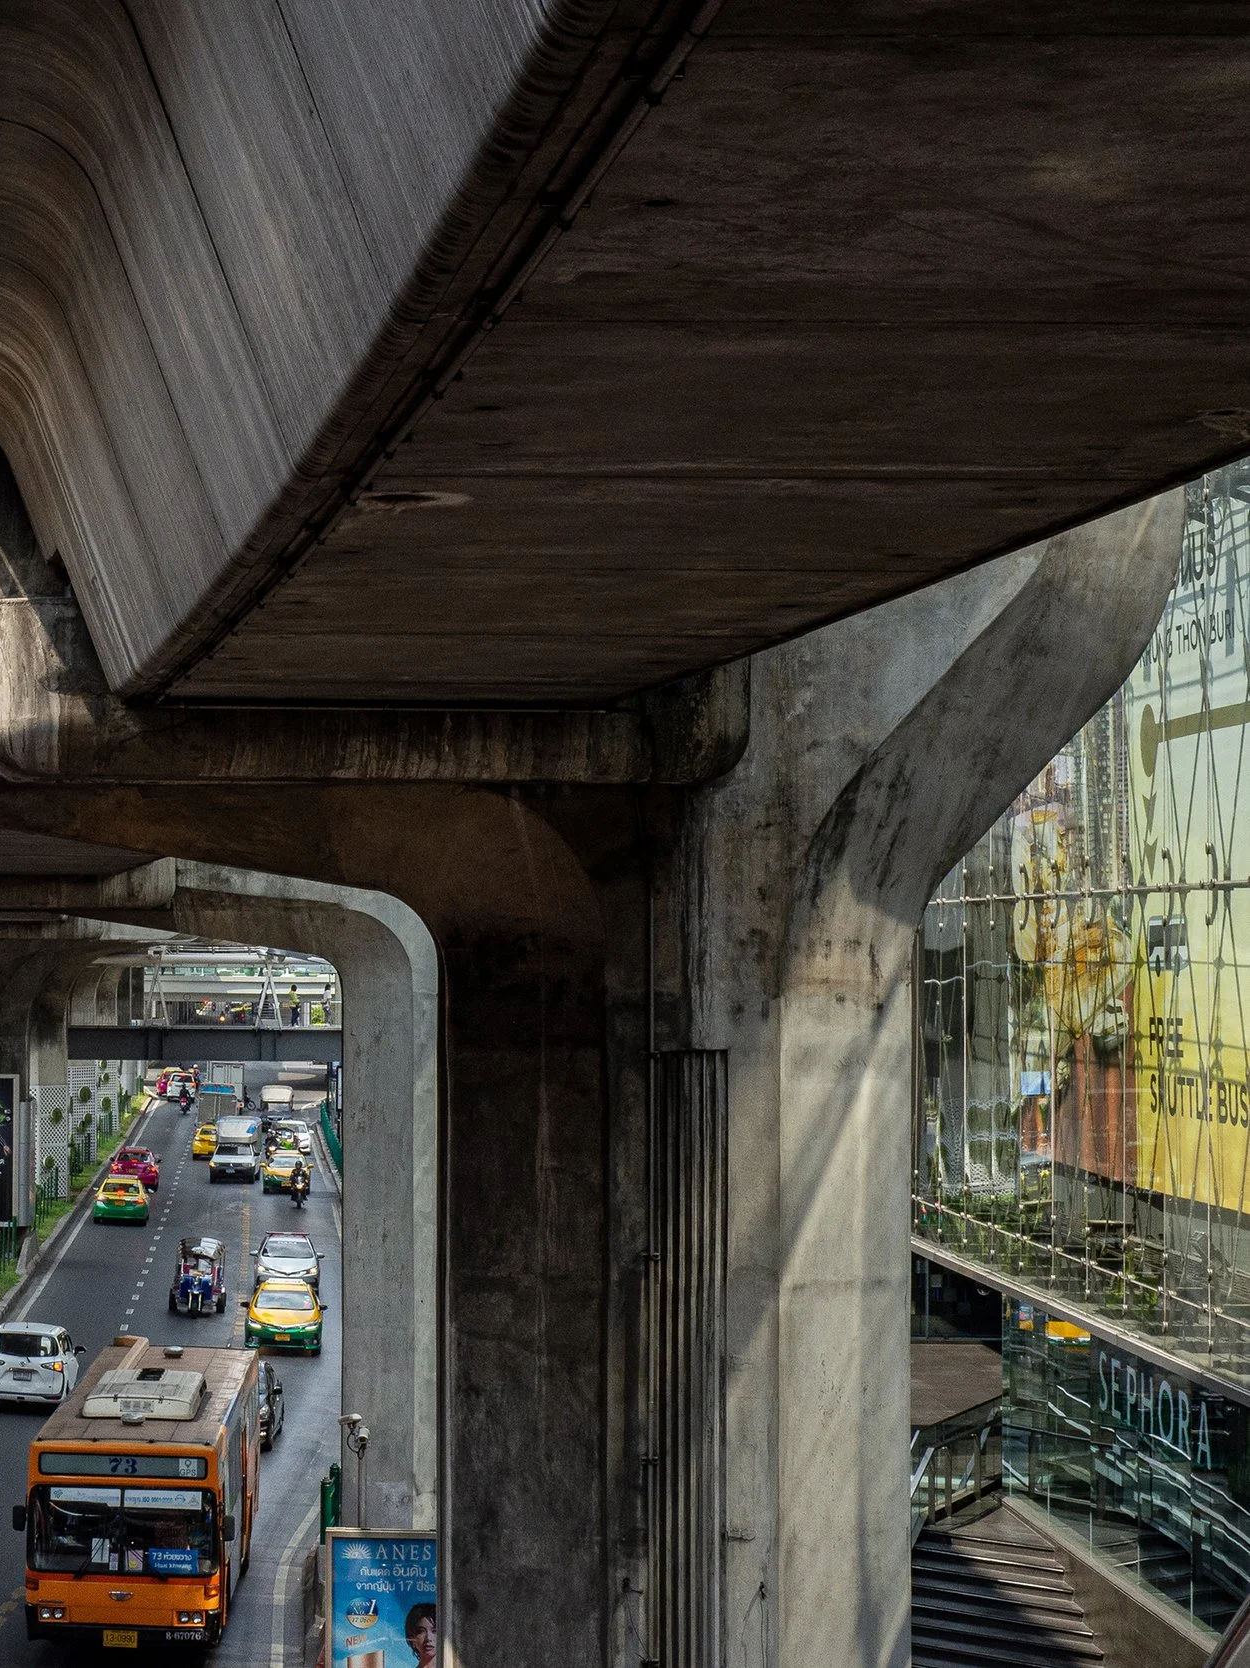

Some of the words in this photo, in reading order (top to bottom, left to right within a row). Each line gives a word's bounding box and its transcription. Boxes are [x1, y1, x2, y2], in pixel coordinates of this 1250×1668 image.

[1149, 1017, 1184, 1058] FREE
[1217, 1082, 1249, 1129] BUS
[1099, 1351, 1212, 1470] SEPHORA
[108, 1457, 138, 1474] 73
[179, 1469, 197, 1477] GPS
[152, 1552, 162, 1560] 73
[392, 1564, 428, 1577] อันดับ
[356, 1579, 395, 1594] จากญี่ปุ่น
[398, 1581, 413, 1591] 17
[165, 1631, 202, 1641] 8-67076
[345, 1634, 367, 1647] NEW
